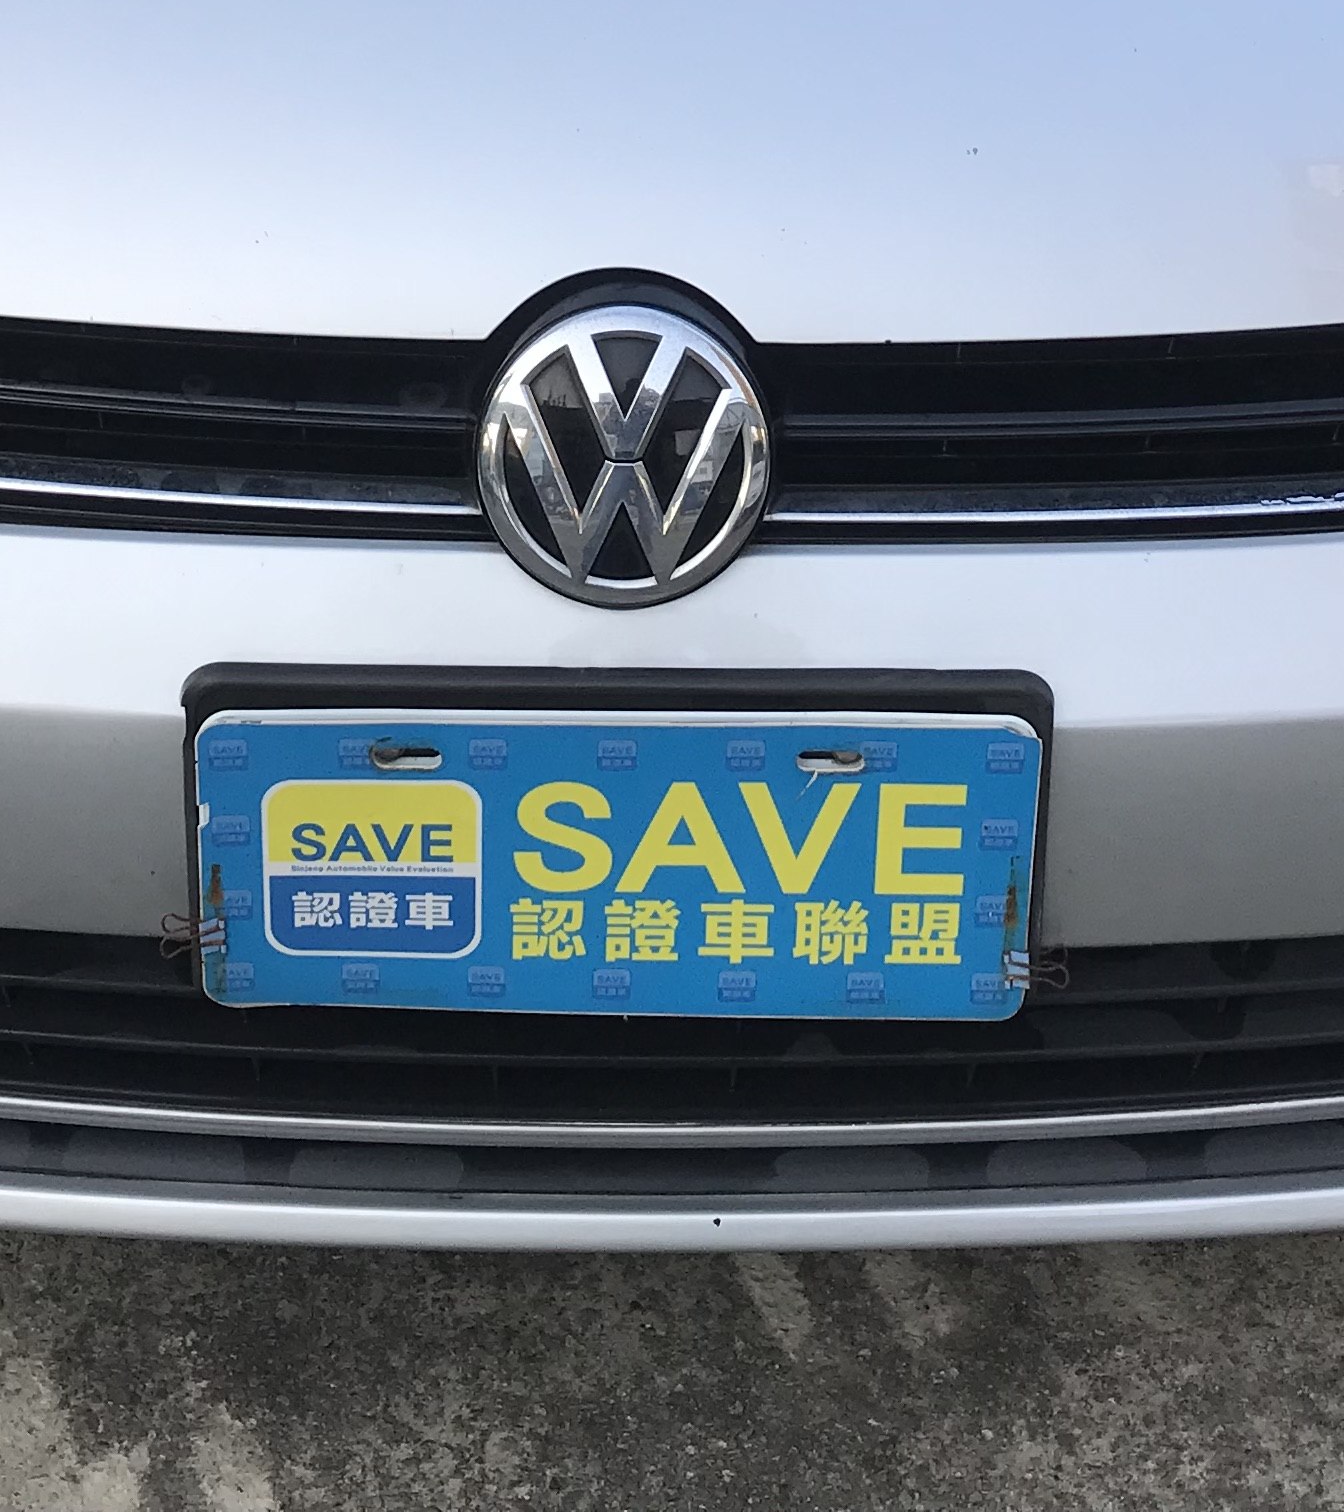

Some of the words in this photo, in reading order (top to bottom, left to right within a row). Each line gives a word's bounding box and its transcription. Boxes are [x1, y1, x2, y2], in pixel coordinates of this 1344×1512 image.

[291, 823, 453, 862] SAVE
[513, 781, 968, 895] SAVE
[291, 891, 454, 930] 認證車
[509, 898, 962, 965] 認證車聯盟
